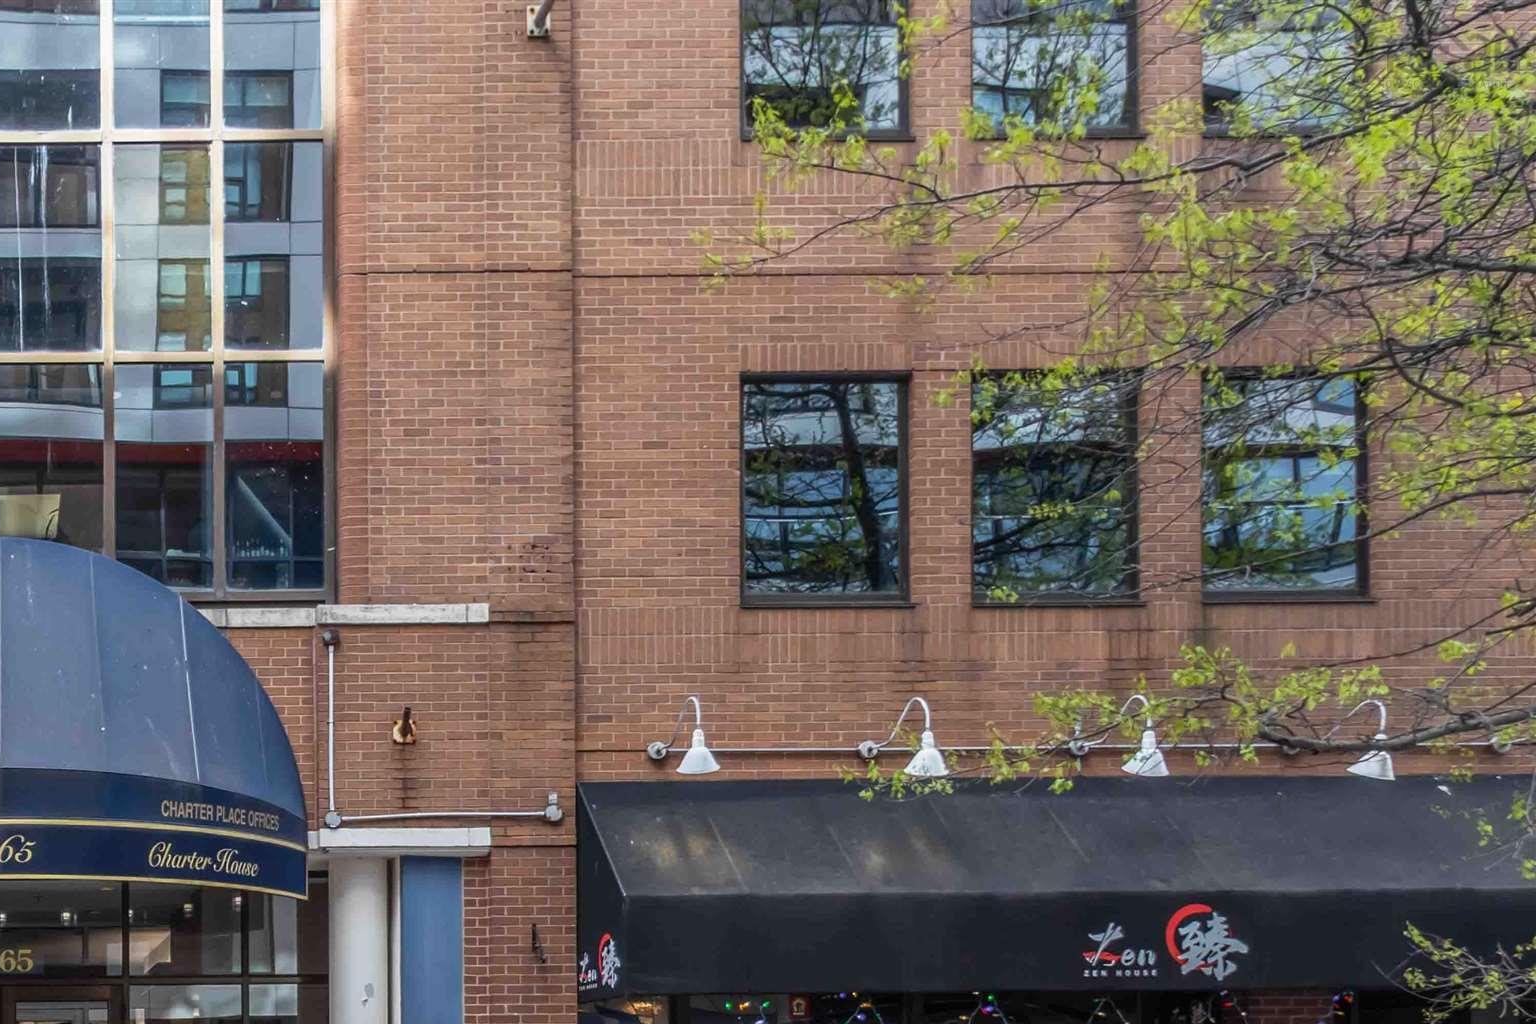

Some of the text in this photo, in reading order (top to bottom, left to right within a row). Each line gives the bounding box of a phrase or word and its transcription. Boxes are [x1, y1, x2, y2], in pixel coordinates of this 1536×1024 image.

[161, 800, 280, 831] CHARTER PLACE OFFICES
[148, 841, 259, 877] Charter House
[1083, 969, 1158, 977] ZEN HOUSE
